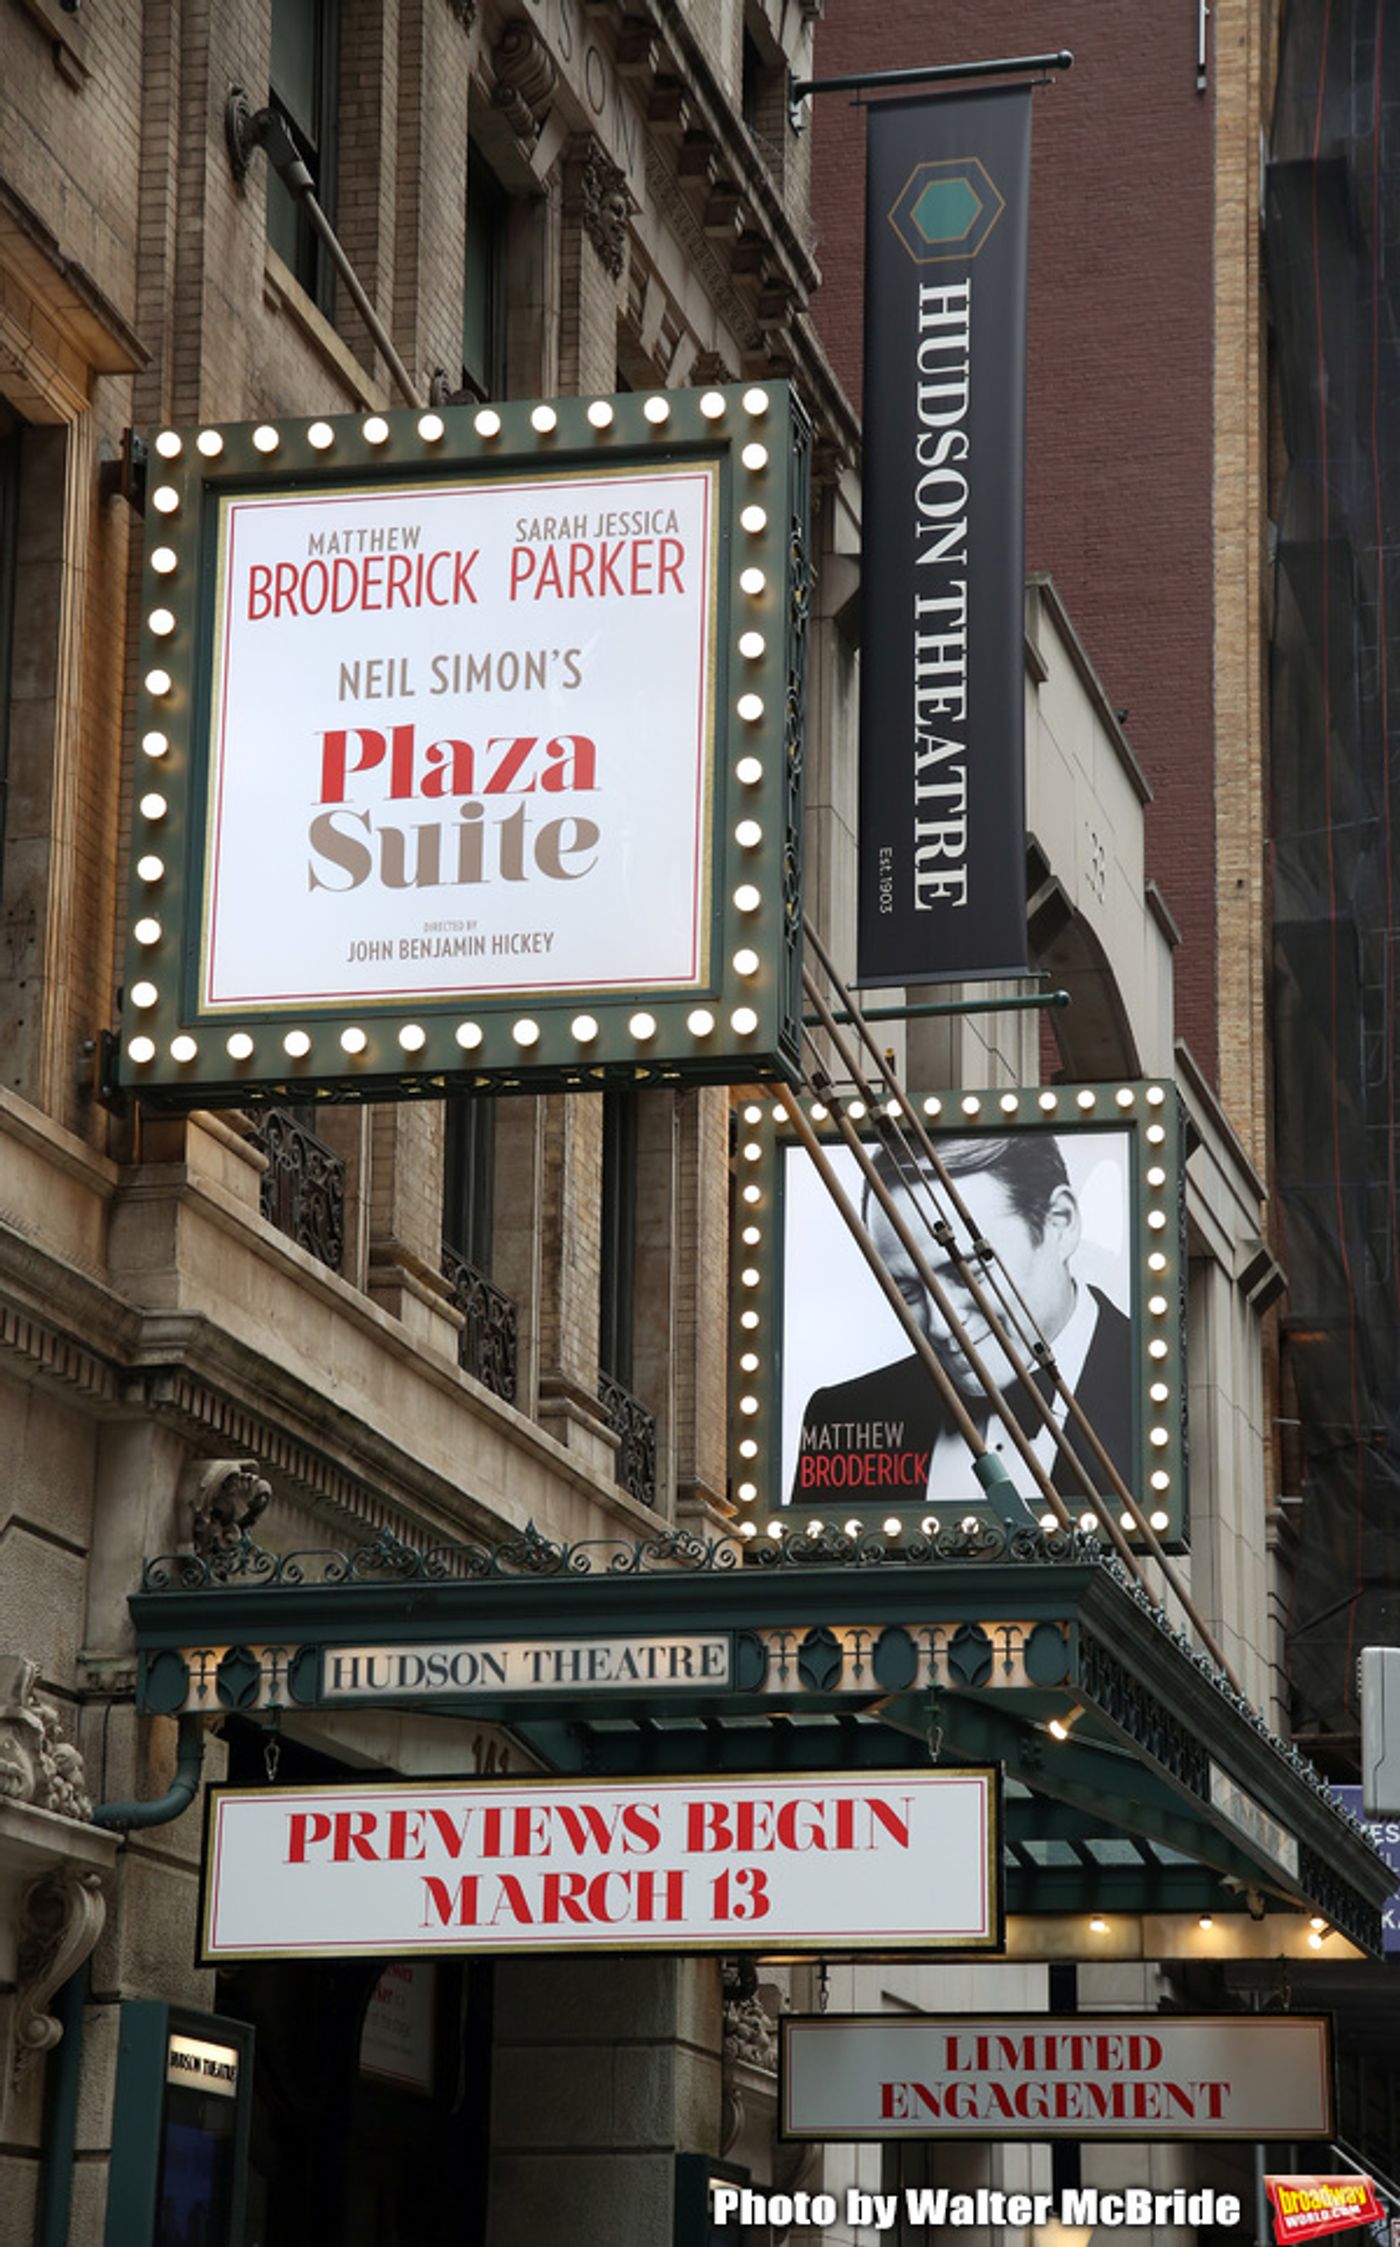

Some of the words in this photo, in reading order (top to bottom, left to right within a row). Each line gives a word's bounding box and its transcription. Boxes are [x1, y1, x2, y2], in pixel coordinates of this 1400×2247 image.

[914, 278, 971, 565] HUDSON
[308, 526, 421, 556] MATTHEW
[516, 514, 588, 543] SARAH
[593, 509, 679, 538] JESSICA
[247, 550, 479, 620] BRODERICK
[509, 538, 685, 601] PARKER
[338, 658, 416, 701] NEIL
[430, 648, 583, 695] SIMON'S
[311, 723, 602, 805] Plaza
[914, 580, 968, 910] THEATRE
[308, 800, 601, 892] Suite
[347, 940, 393, 963] JOHN
[399, 935, 486, 960] BENJAMIN
[492, 931, 555, 955] HICKEY
[423, 921, 464, 933] DIRECTED
[466, 920, 478, 931] BY
[802, 1421, 905, 1451] MATTHEW
[801, 1452, 930, 1488] BRODERICK
[331, 1649, 509, 1692] HUDSON
[523, 1643, 728, 1684] THEATRE
[283, 1802, 662, 1864] PREVIEWS
[682, 1797, 915, 1854] BEGIN
[418, 1869, 690, 1929] MARCH
[708, 1866, 771, 1922] 13
[942, 2034, 1164, 2072] LIMITED
[878, 2080, 1232, 2120] ENGAGEMENT
